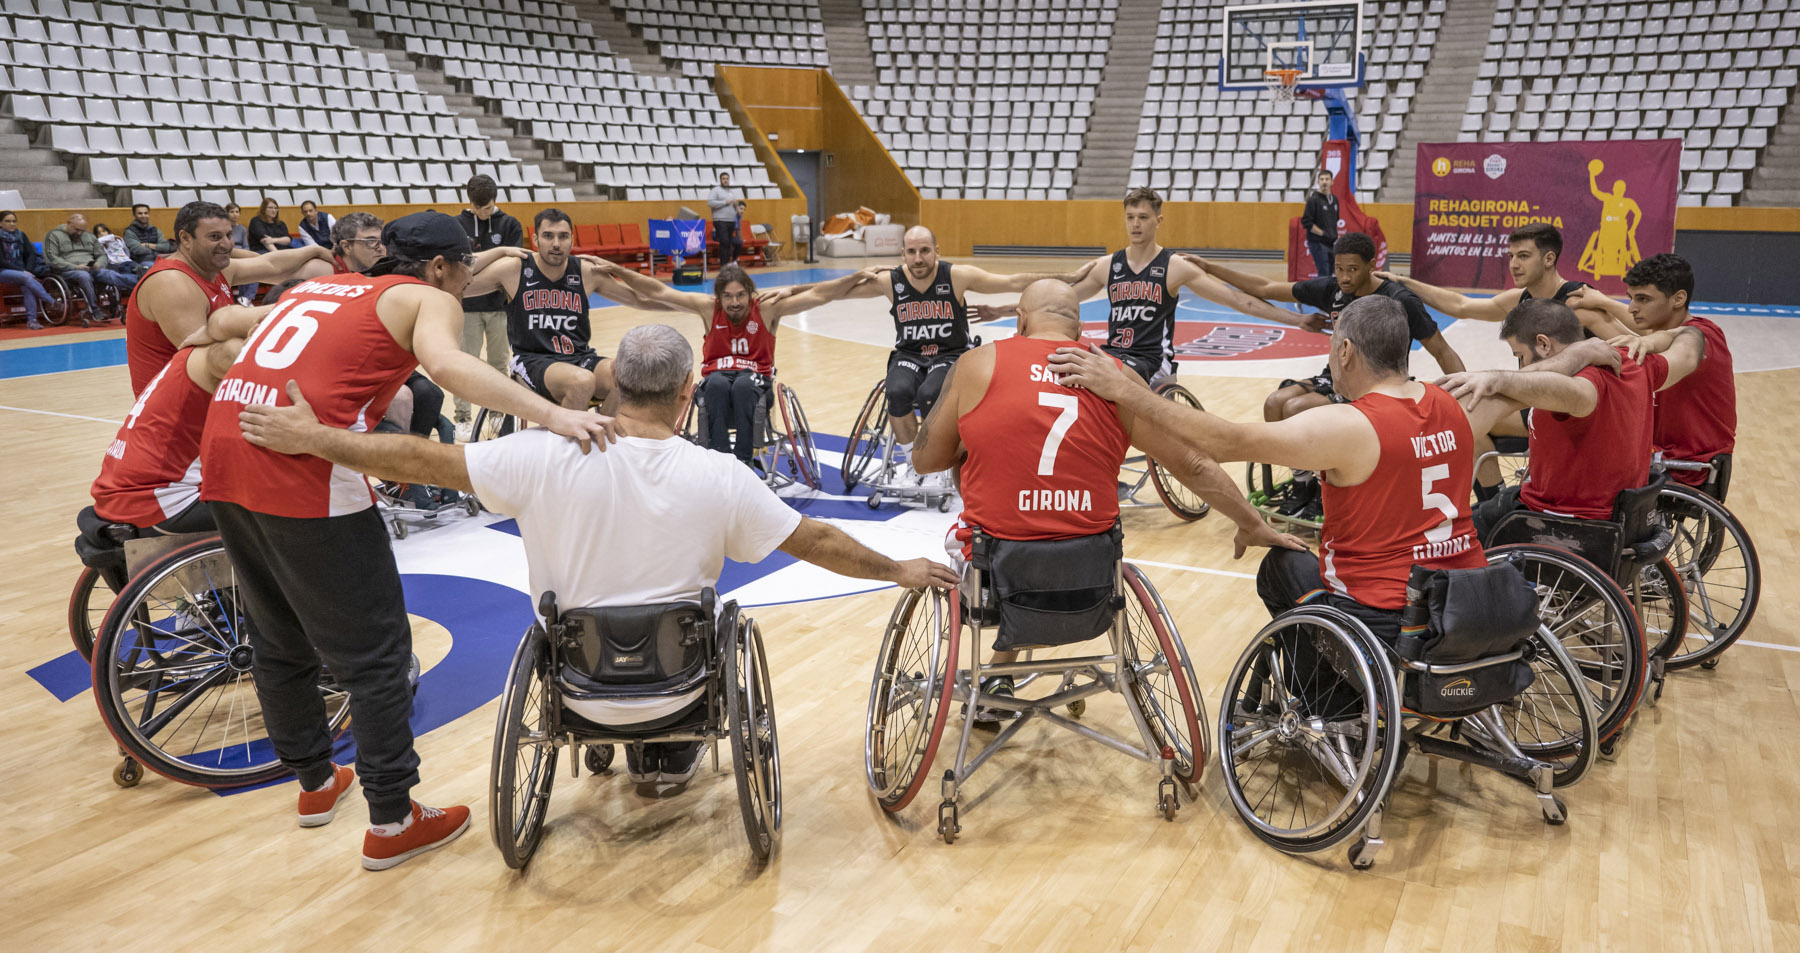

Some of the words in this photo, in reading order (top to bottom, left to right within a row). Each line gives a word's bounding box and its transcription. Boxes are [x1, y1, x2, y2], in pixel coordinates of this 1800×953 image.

[1429, 200, 1529, 213] REHAGIRONA
[1428, 213, 1499, 227] BÀSQUET
[1502, 215, 1563, 228] GIRONA
[1427, 233, 1457, 243] JUNTS
[1458, 234, 1470, 244] EN
[1472, 234, 1483, 244] EL
[1468, 246, 1481, 256] EN
[1482, 247, 1494, 257] EL
[523, 289, 582, 314] GIRONA
[1109, 281, 1162, 305] GIRONA
[897, 300, 954, 323] GIRONA
[1112, 305, 1157, 321] FIATC
[528, 314, 578, 330] FIATC
[903, 322, 953, 340] FIATC
[233, 298, 342, 370] 16
[551, 334, 574, 354] 18
[1111, 327, 1134, 348] 28
[731, 337, 749, 355] 10
[736, 358, 757, 368] REHA
[214, 379, 278, 407] GIRONA
[1037, 391, 1079, 476] 7
[1410, 430, 1457, 459] VÍCTOR
[1018, 489, 1092, 511] GIRONA
[1421, 463, 1459, 544] 5
[1413, 534, 1471, 560] GIRONA
[1440, 687, 1474, 697] QUICKIE
